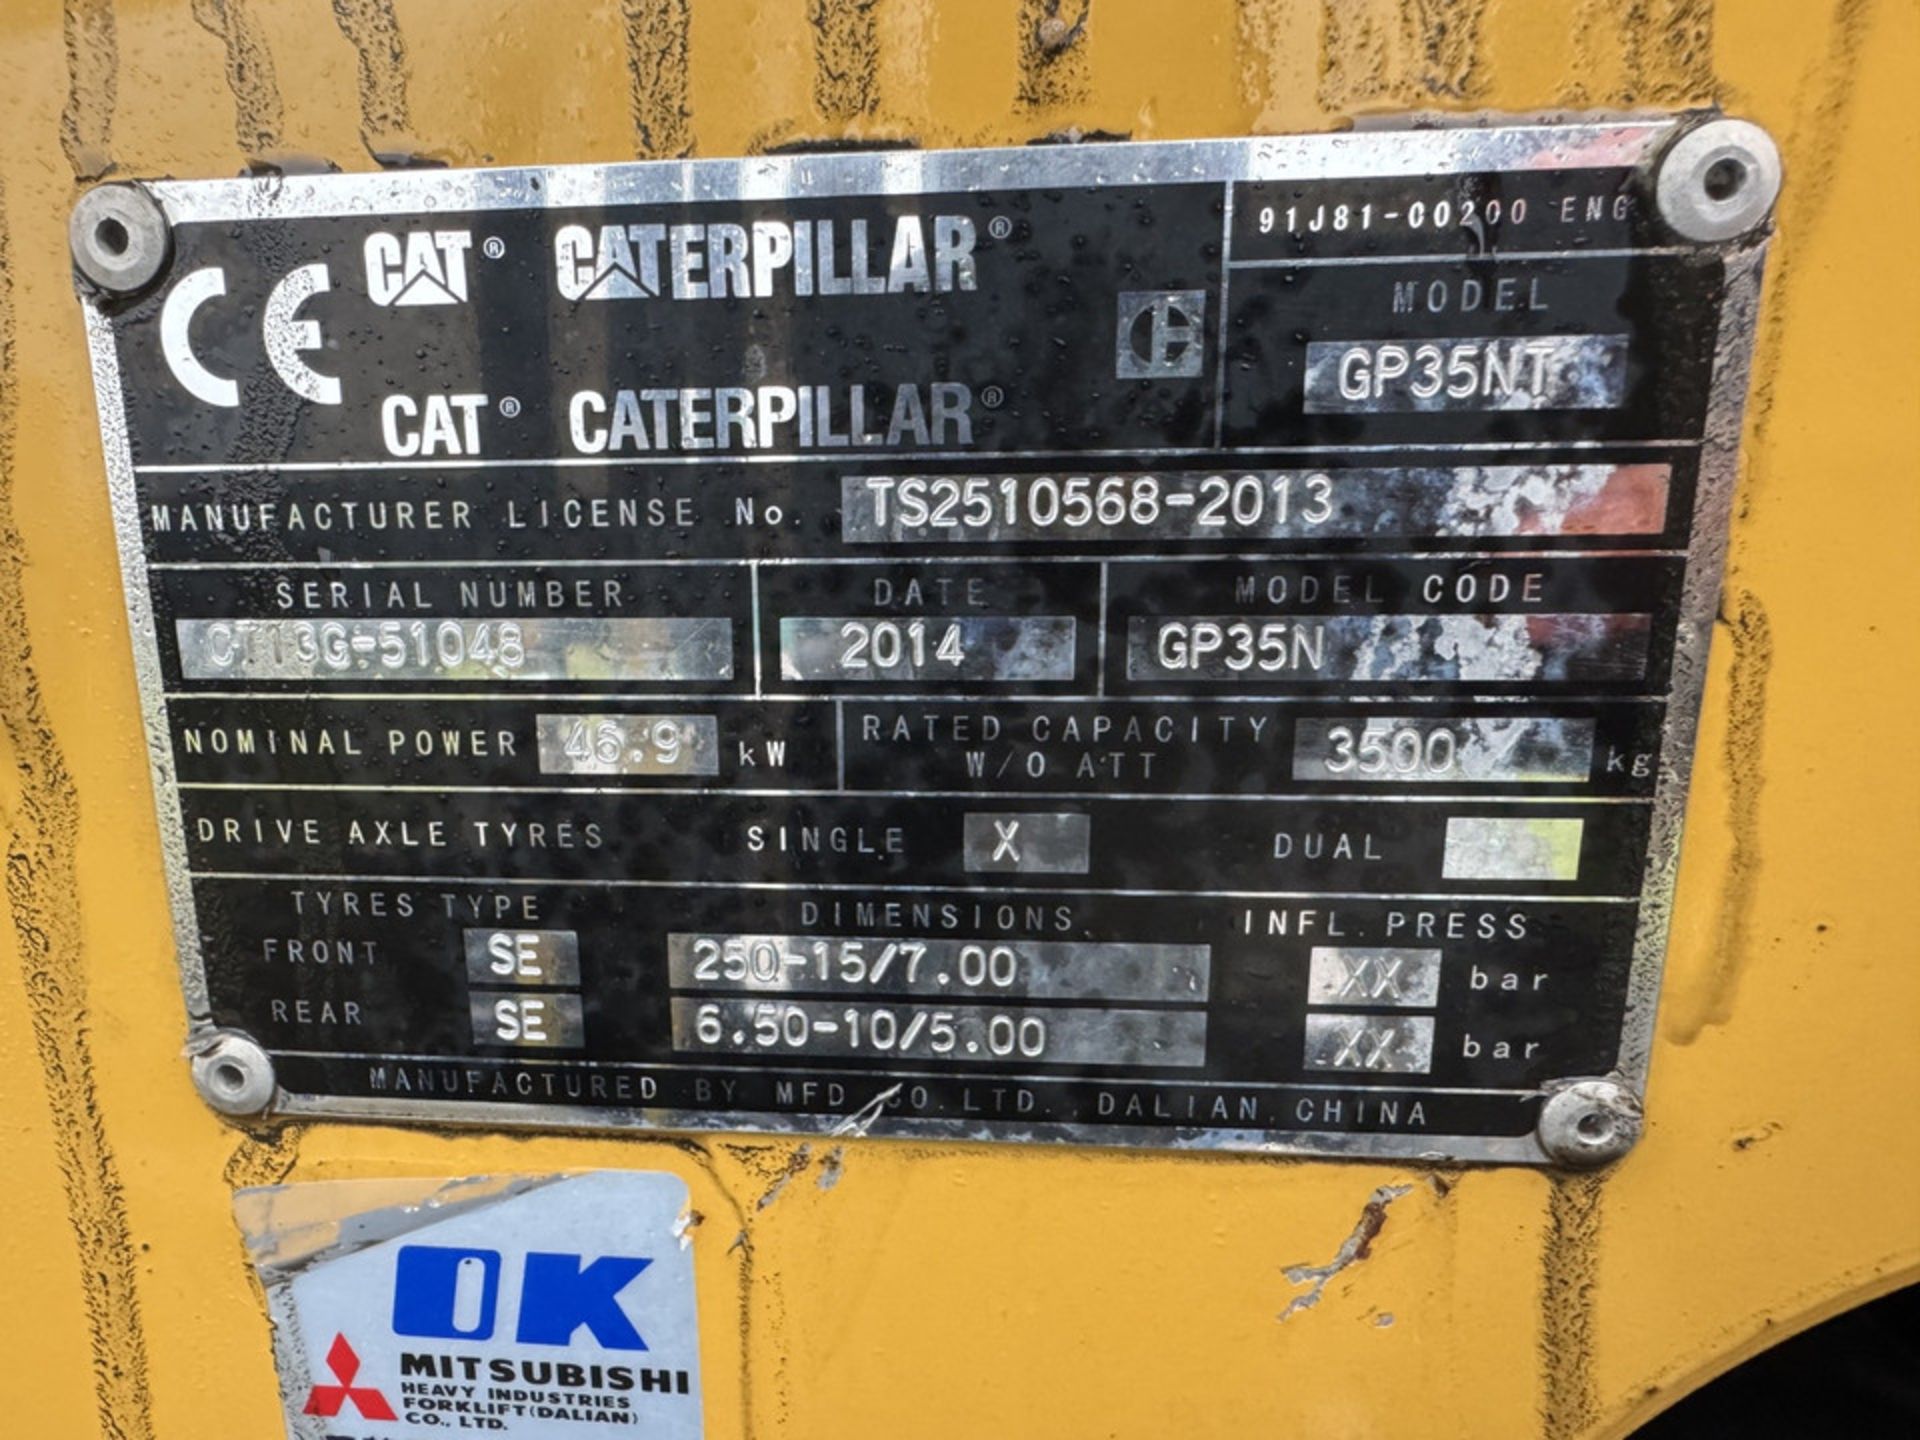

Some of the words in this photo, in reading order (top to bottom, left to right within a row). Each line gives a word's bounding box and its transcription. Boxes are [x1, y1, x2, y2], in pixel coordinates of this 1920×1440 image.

[1561, 194, 1630, 223] ENG
[1393, 277, 1550, 314] MODEL
[160, 263, 342, 408] CE
[1338, 342, 1556, 401] GP35NT
[151, 500, 473, 534] MANUFACTURER
[508, 497, 696, 529] LICENSE
[735, 496, 802, 528] No.
[867, 473, 1334, 528] TS2510568-2013
[276, 582, 433, 611] SERIAL
[461, 580, 624, 610] NUMBER
[874, 577, 986, 608] DATE
[1235, 574, 1385, 604] MODEL
[1423, 573, 1545, 603] CODE
[839, 621, 967, 670] 2014
[1157, 621, 1326, 673] GP35N
[183, 728, 363, 757] NOMINAL
[389, 729, 519, 758] POWER
[562, 719, 683, 766] 46.9
[862, 714, 1001, 743] RATED
[1032, 714, 1268, 743] CAPACITY
[739, 740, 786, 769] kW
[965, 751, 1046, 780] W/O
[1076, 751, 1158, 780] ATT
[1324, 726, 1459, 775] 3500
[1607, 750, 1654, 779] kg
[199, 816, 321, 844] DRIVE
[348, 819, 447, 846] AXLE
[473, 820, 604, 848] TYRES
[746, 826, 904, 855] SINGLE
[992, 820, 1021, 862] X
[1273, 832, 1383, 862] DUAL
[290, 891, 415, 919] TYRES
[443, 893, 540, 921] TYPE
[801, 902, 1074, 932] DIMENSIONS
[1387, 911, 1529, 940] PRESS
[262, 938, 380, 966] FRONT
[488, 933, 545, 977] SE
[692, 939, 1019, 988] 250-15/7.00
[1339, 955, 1403, 1000] XX
[1470, 964, 1549, 992] bar
[271, 1000, 362, 1026] REAR
[495, 998, 548, 1042] SE
[696, 1004, 1047, 1057] 6.50-10/5.00
[1333, 1027, 1396, 1070] XX
[1461, 1033, 1541, 1060] bar
[368, 1066, 659, 1100] MANUFACTURED
[695, 1079, 738, 1103] BY
[775, 1080, 847, 1107] MFD
[1295, 1097, 1428, 1127] CHINA
[392, 1244, 655, 1352] OK
[400, 1352, 690, 1395] MITSUBISHI
[401, 1380, 476, 1399] HEAVY
[487, 1385, 631, 1410] INDUSTRIES
[459, 1413, 509, 1432] LTD.
